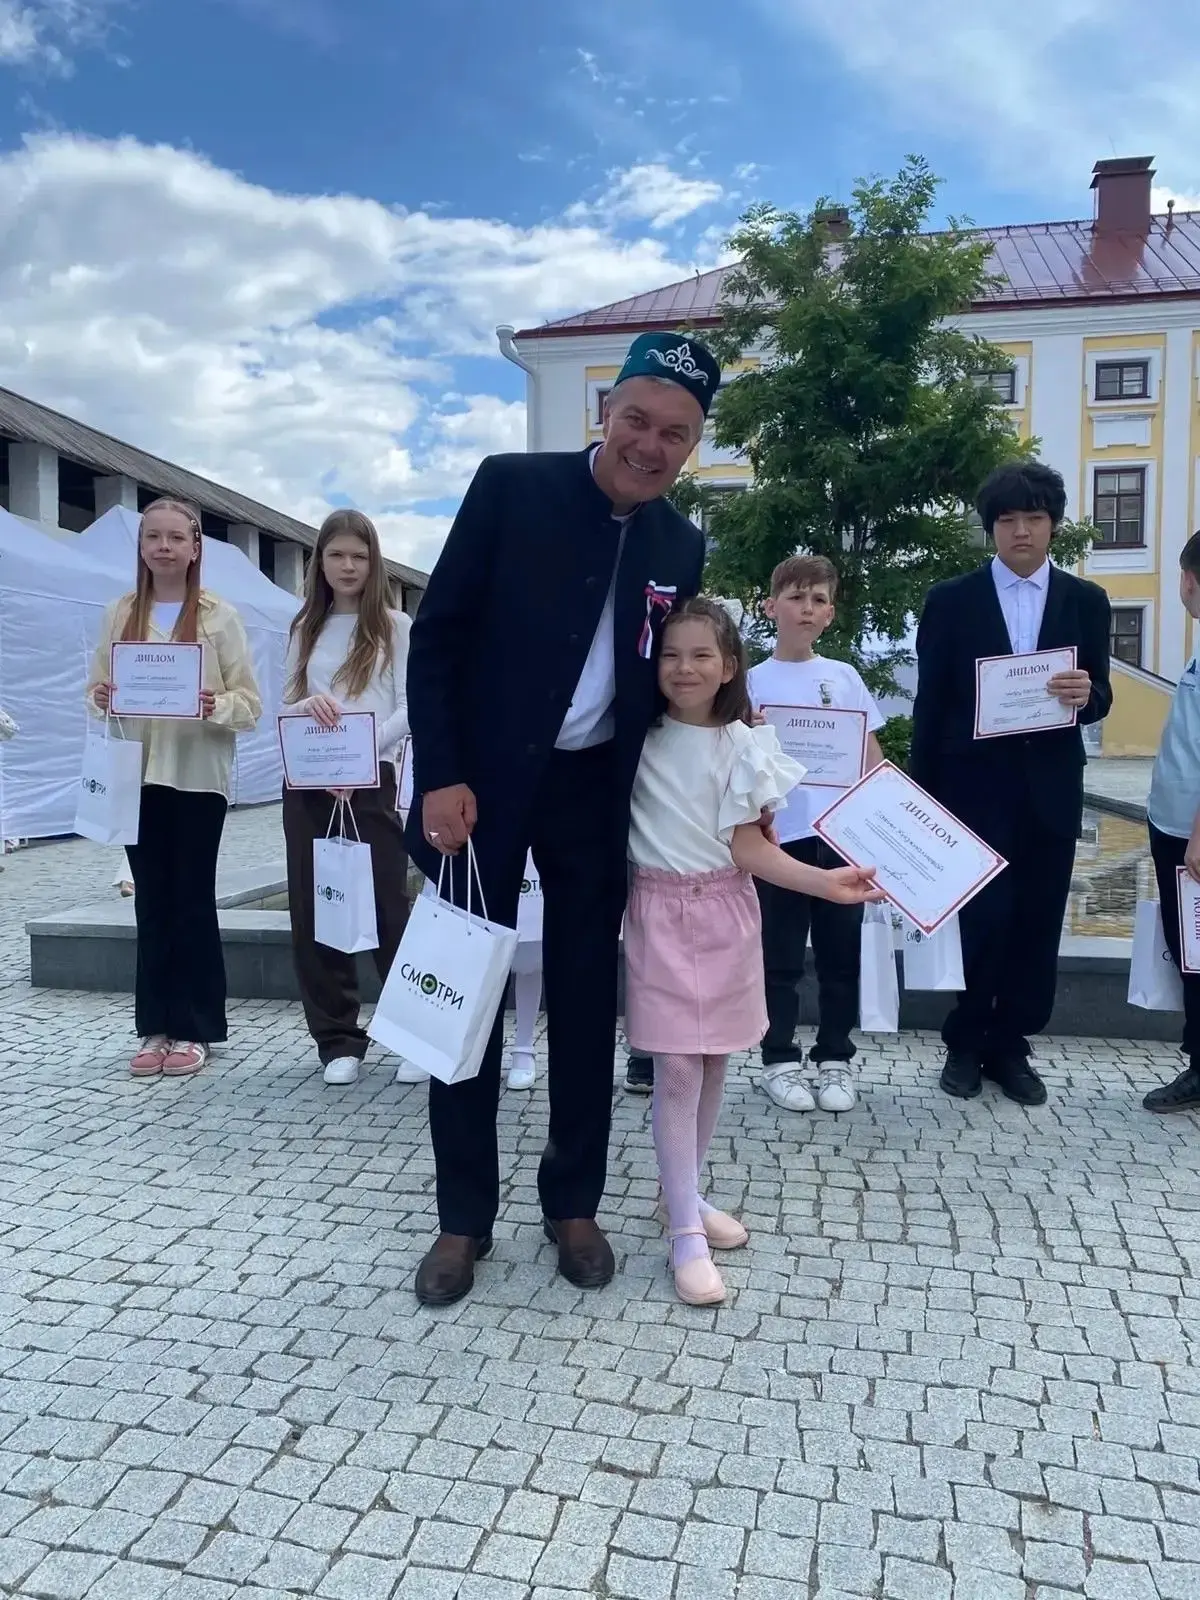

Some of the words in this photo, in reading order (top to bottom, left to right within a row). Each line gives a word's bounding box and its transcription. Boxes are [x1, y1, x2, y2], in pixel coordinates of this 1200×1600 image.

[135, 654, 175, 663] ДИПЛОМ
[1006, 664, 1049, 678] ДИПЛОМ
[304, 725, 347, 736] ДИПЛОМ
[786, 718, 835, 729] ДИПЛОМ
[899, 800, 958, 848] ДИПЛОМ
[317, 885, 344, 903] СМОТРИ
[400, 963, 464, 1010] СМОТРИ
